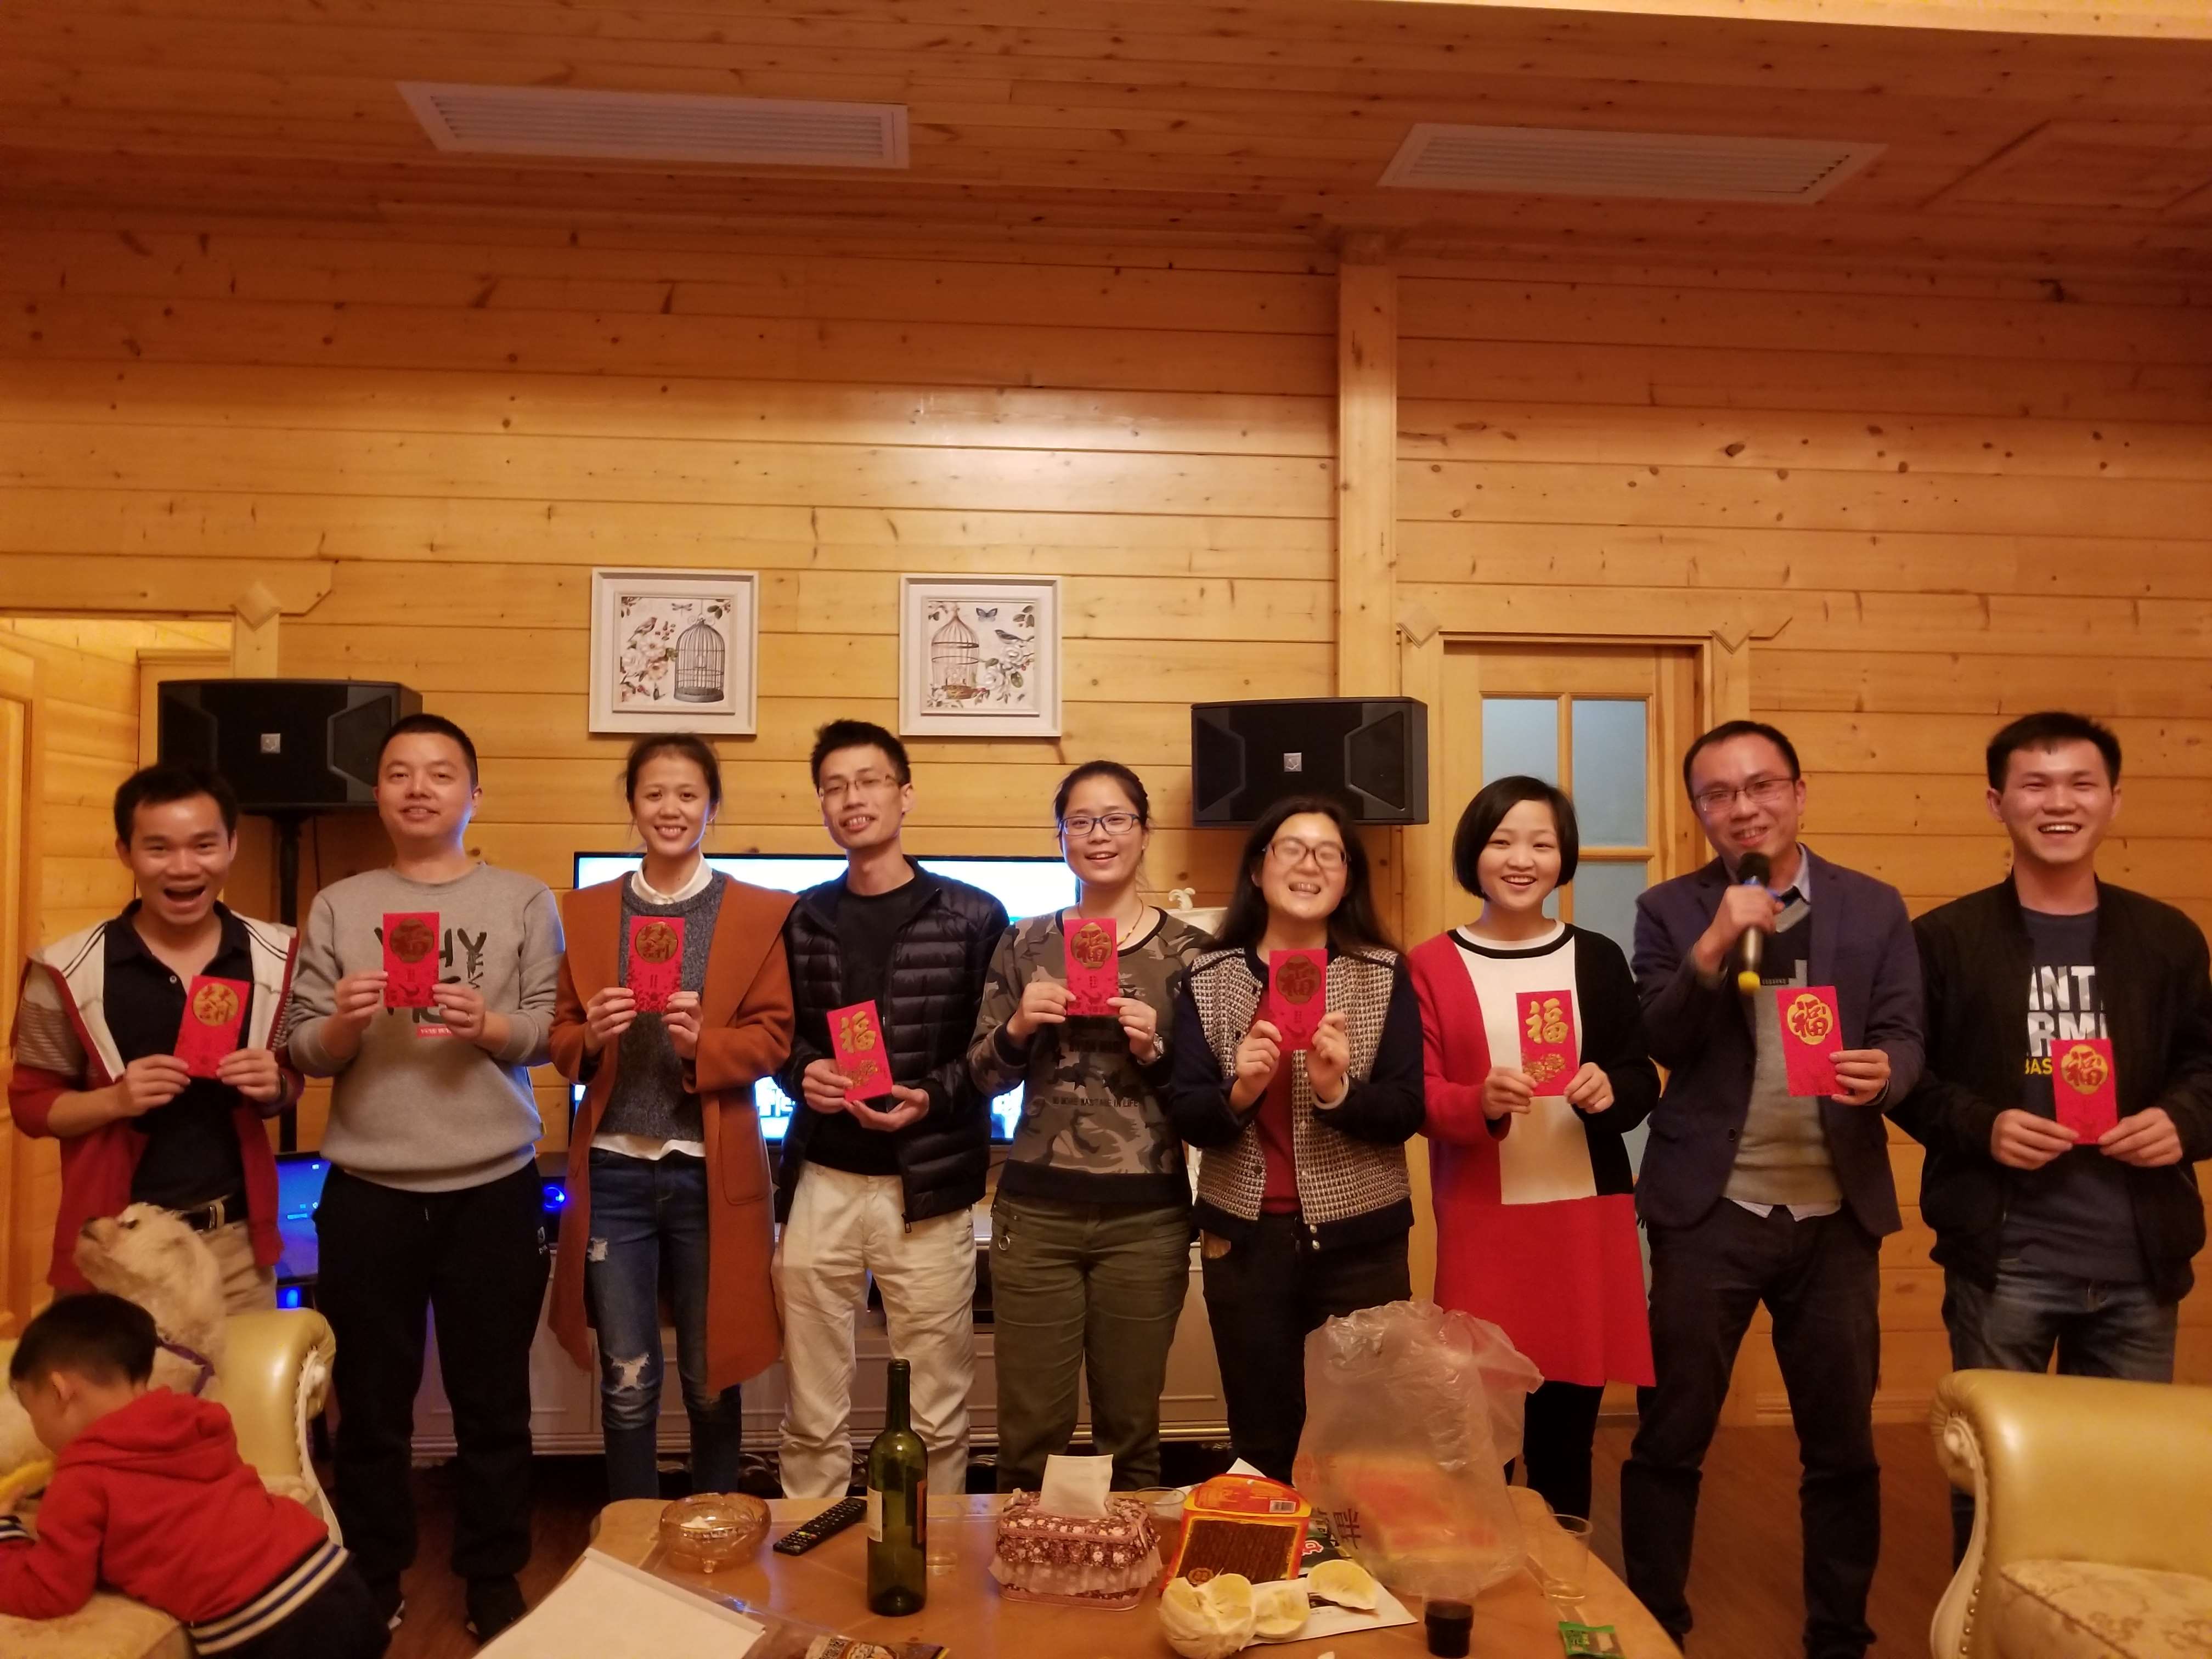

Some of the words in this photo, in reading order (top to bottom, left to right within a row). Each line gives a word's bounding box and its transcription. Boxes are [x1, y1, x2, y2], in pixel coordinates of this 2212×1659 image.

[1075, 929, 1109, 963] 福
[1279, 961, 1317, 997] 福
[839, 1010, 876, 1054] 福
[1525, 997, 1569, 1045] 福
[1791, 999, 1829, 1038] 福
[2066, 1050, 2103, 1086] 福
[1123, 1099, 1139, 1108] LIFE
